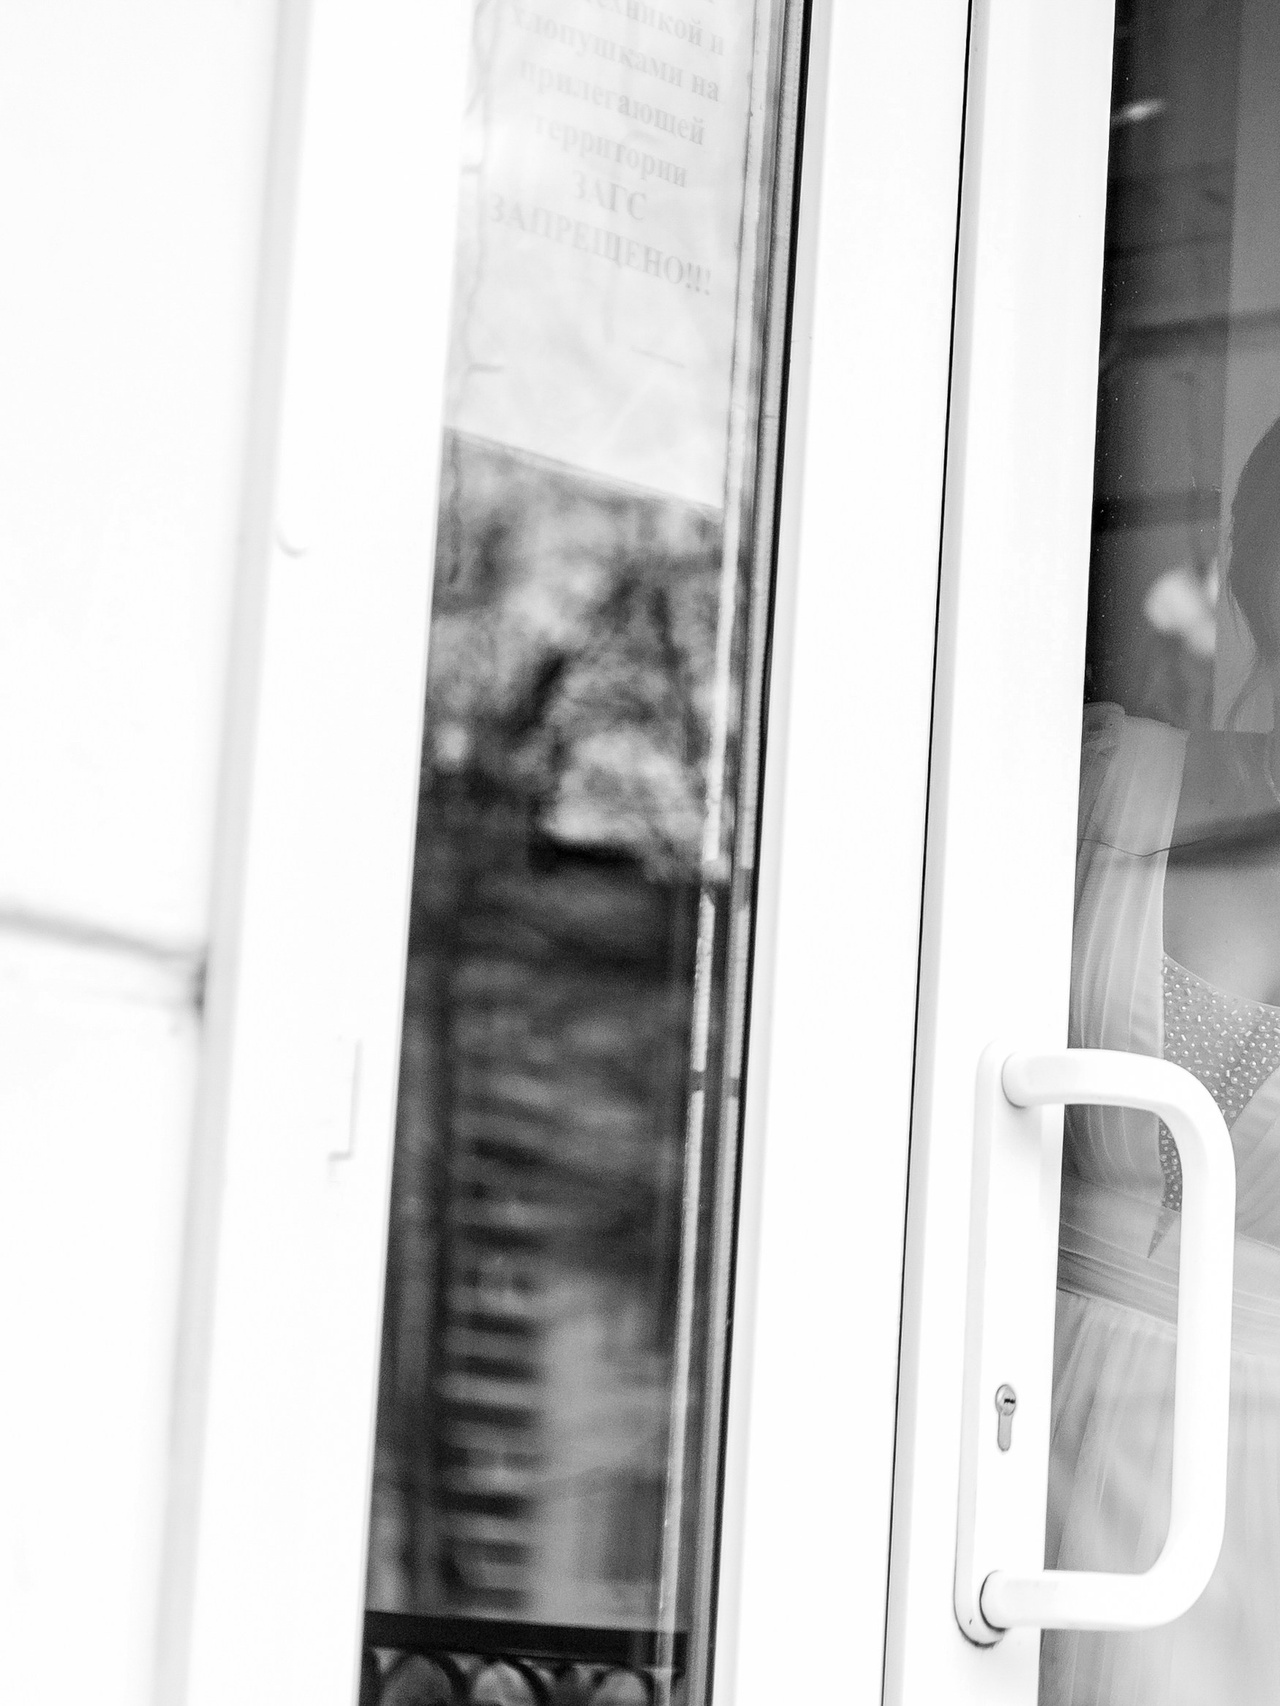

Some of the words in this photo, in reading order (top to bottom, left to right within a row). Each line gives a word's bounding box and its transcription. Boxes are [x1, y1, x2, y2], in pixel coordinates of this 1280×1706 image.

[519, 58, 706, 147] прилегающей
[691, 74, 720, 102] на
[534, 113, 688, 189] территории
[573, 169, 648, 222] ЗАГС
[489, 191, 713, 297] ЗАПРЕЩЕНО!!!
